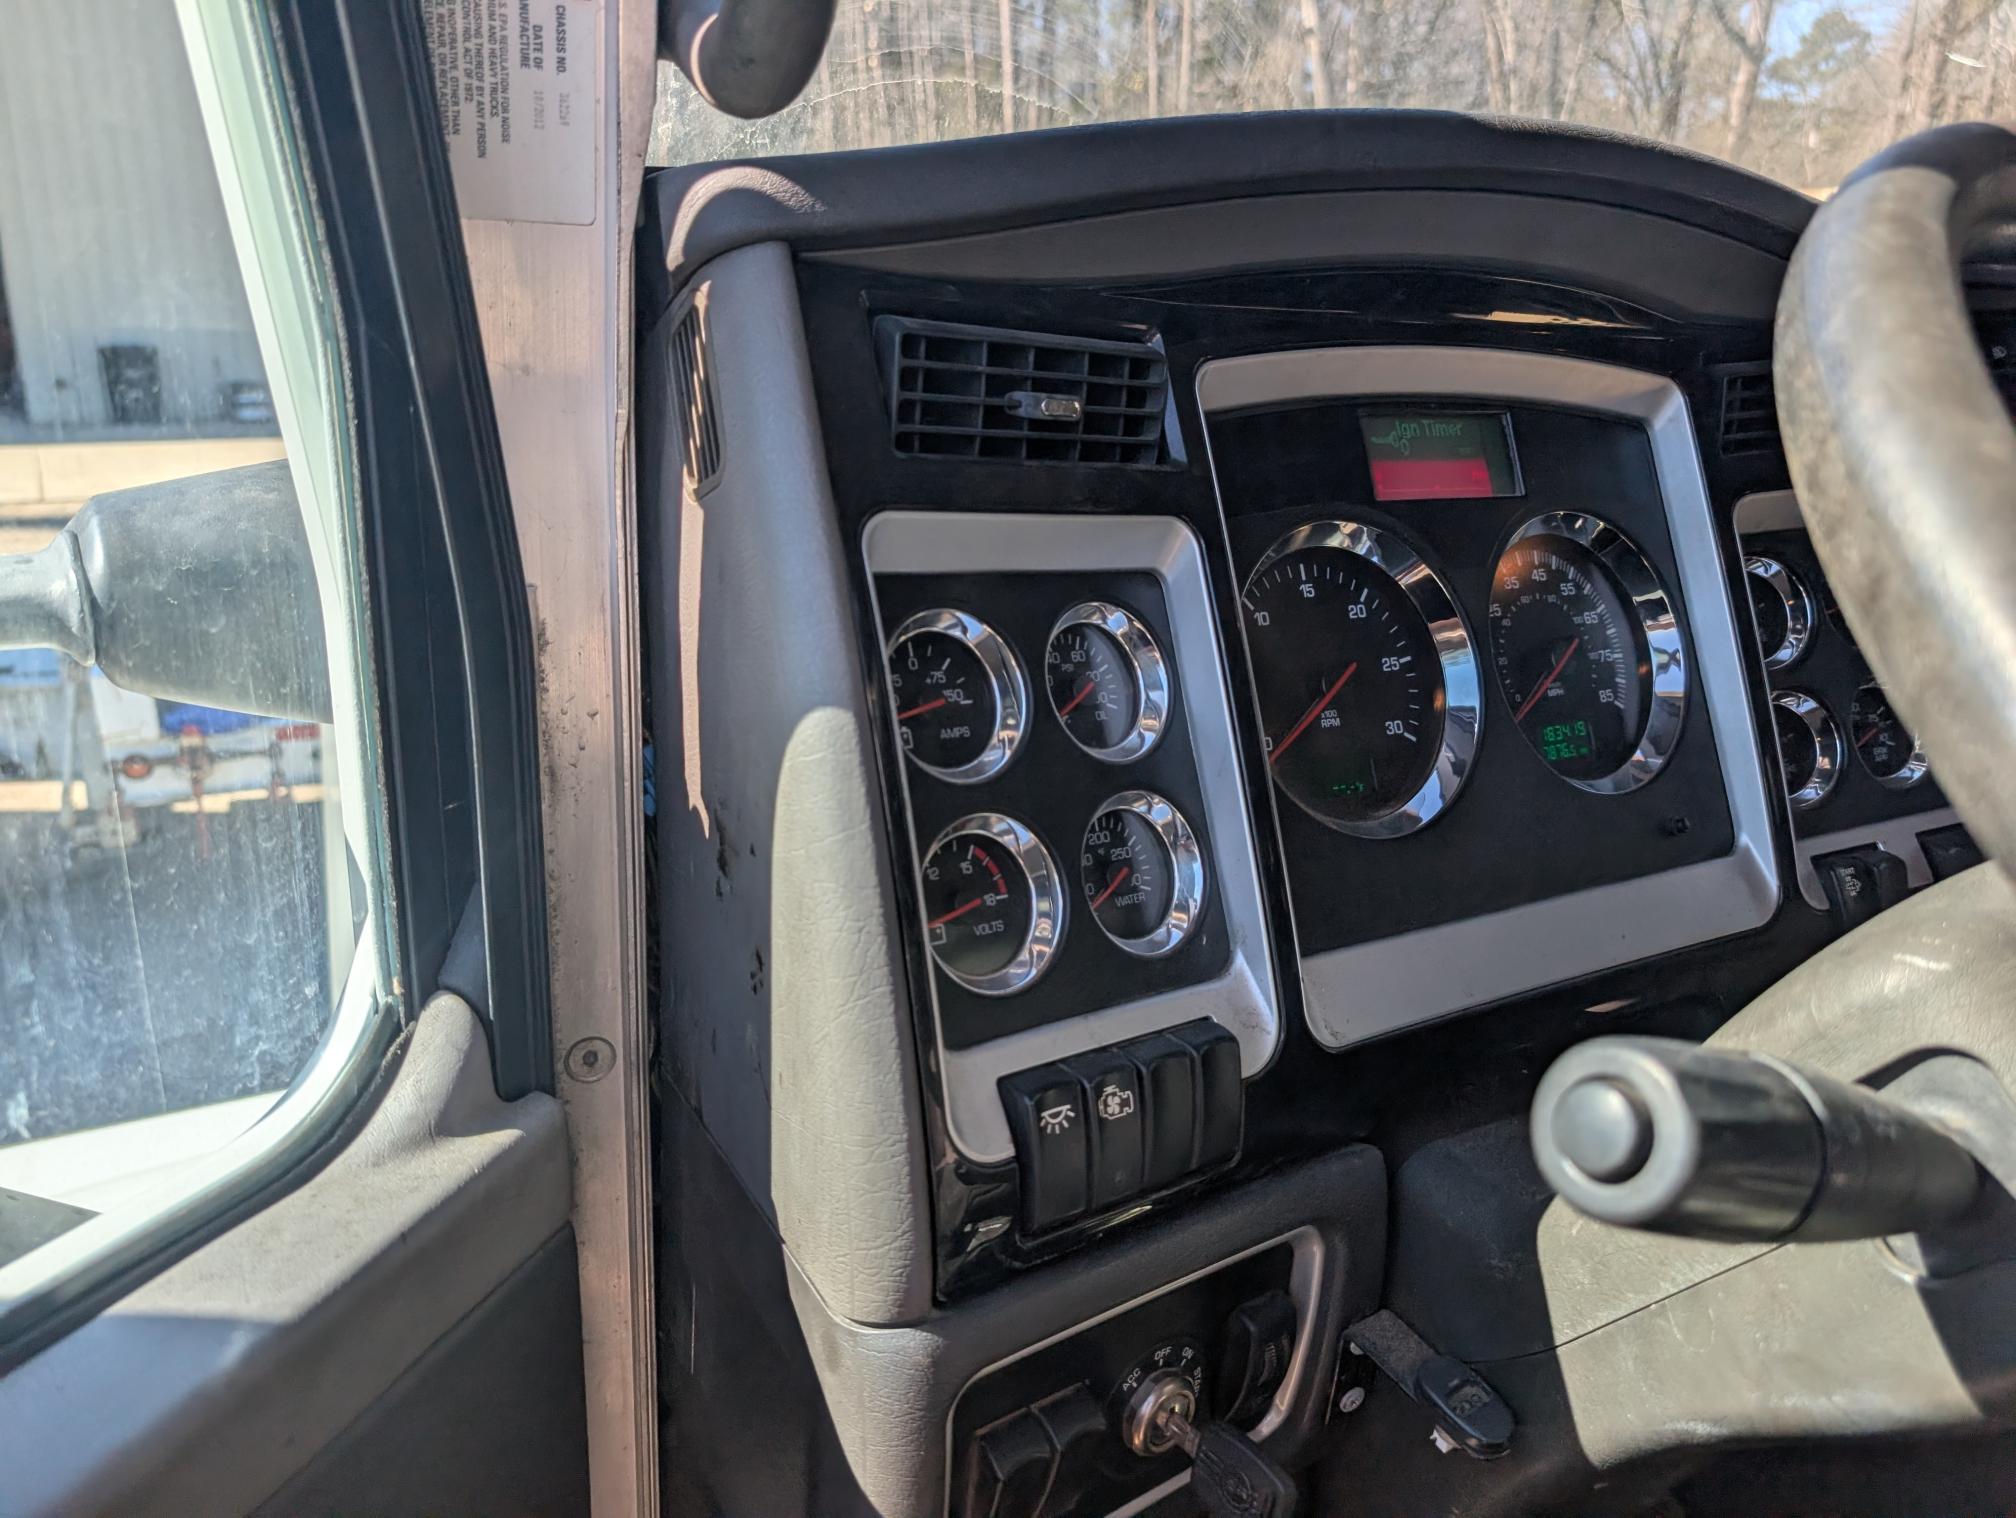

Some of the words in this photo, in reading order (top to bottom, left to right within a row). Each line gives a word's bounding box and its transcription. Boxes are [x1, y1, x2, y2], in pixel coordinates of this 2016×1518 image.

[499, 13, 509, 33] EPA
[556, 4, 567, 53] CHASSIS
[487, 23, 497, 46] AND
[519, 0, 531, 70] NUFACTURE
[532, 25, 544, 54] DATE
[437, 52, 448, 67] OR
[463, 46, 473, 66] ACT
[474, 41, 485, 83] THEREOF
[488, 47, 499, 79] HEAVY
[532, 56, 544, 71] OF
[499, 34, 510, 94] REGULATION
[555, 56, 567, 76] NO.
[463, 67, 474, 80] OF
[449, 75, 460, 108] OTHER
[475, 85, 485, 98] BY
[475, 99, 486, 121] ANY
[500, 96, 511, 114] FOR
[451, 109, 461, 136] THAN
[500, 116, 511, 144] NOISE
[476, 121, 487, 159] PERSON
[1396, 419, 1420, 439] Ign
[1422, 419, 1464, 437] Timer
[1531, 568, 1547, 582] 45
[1300, 583, 1316, 598] 15
[1504, 576, 1520, 590] 35
[1560, 583, 1576, 596] 55
[1348, 603, 1367, 618] 20
[1583, 611, 1599, 625] 65
[1254, 611, 1270, 626] 10
[1071, 650, 1086, 662] 60
[1381, 656, 1400, 671] 25
[1599, 649, 1614, 663] 75
[908, 658, 918, 670] 0
[1548, 688, 1565, 698] MPH
[1599, 689, 1615, 703] 85
[1321, 718, 1341, 728] RPM
[1385, 720, 1404, 735] 30
[940, 725, 971, 739] AMPS
[1543, 720, 1587, 742] 183419
[1088, 830, 1111, 846] 200
[1110, 846, 1132, 861] 250
[927, 866, 941, 880] 12
[960, 860, 973, 875] 15
[983, 893, 997, 906] 18
[1115, 892, 1146, 908] WATER
[972, 919, 1005, 937] VOLTS
[1154, 1346, 1173, 1360] OFF
[1182, 1347, 1194, 1360] ON
[1122, 1368, 1141, 1392] ACC
